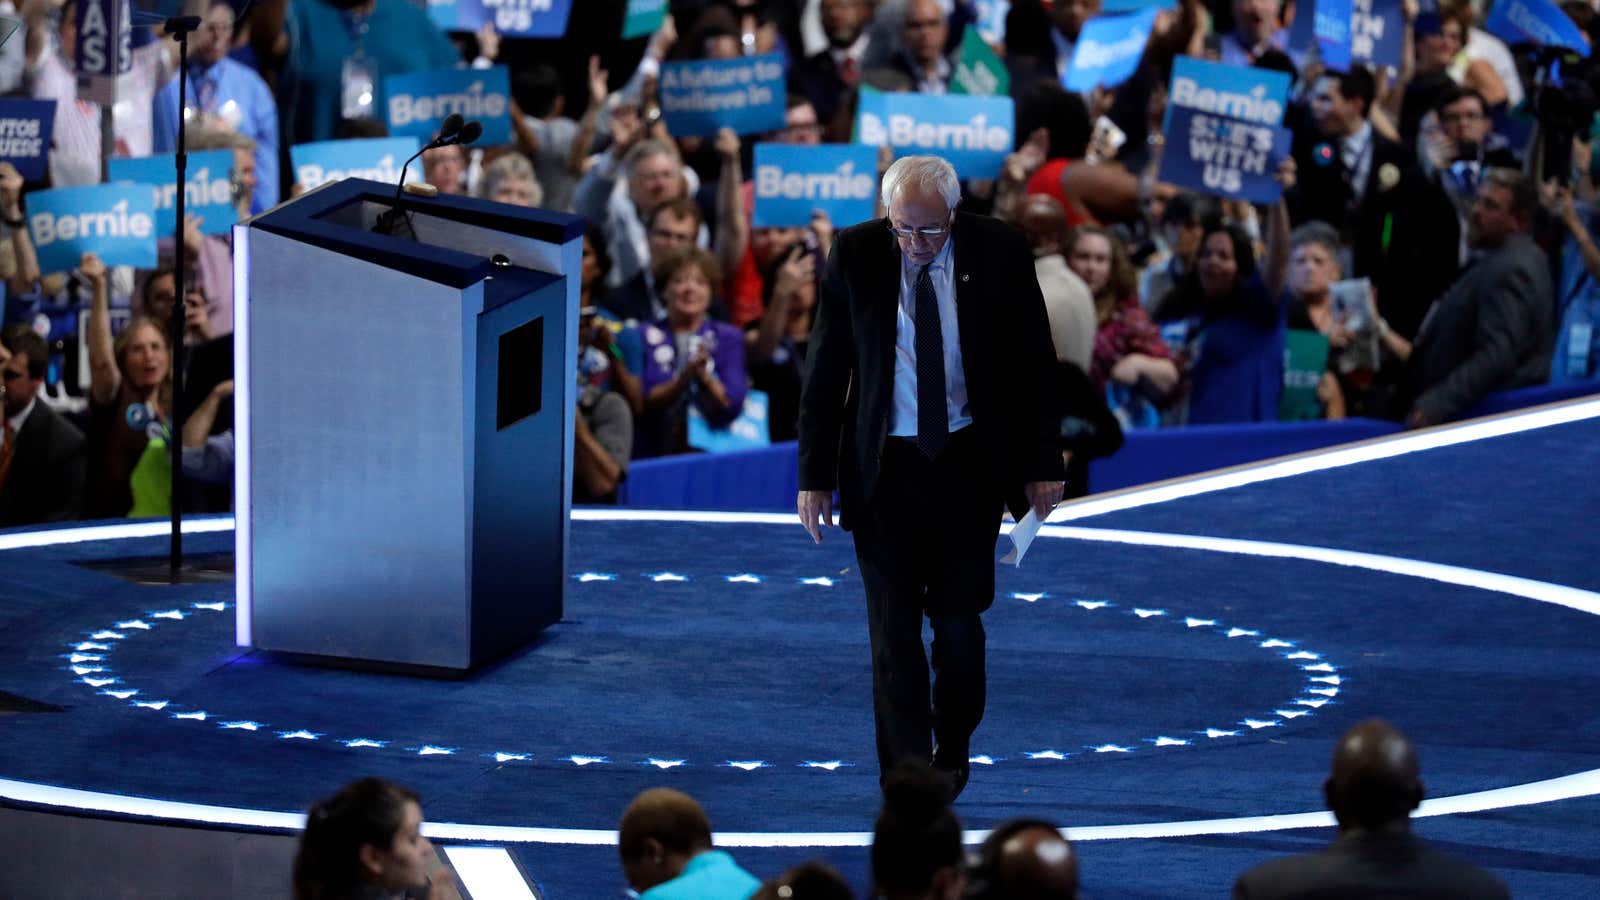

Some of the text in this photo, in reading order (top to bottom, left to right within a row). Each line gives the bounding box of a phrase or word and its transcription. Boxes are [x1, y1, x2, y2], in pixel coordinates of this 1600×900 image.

[662, 61, 781, 88] A future to
[748, 83, 772, 104] in
[388, 80, 505, 127] Bernie
[1172, 77, 1282, 126] Bernie
[888, 113, 1010, 152] Bernie
[1189, 138, 1267, 176] WITH
[153, 167, 232, 209] rnie
[755, 162, 874, 200] Bernie
[1203, 160, 1242, 193] US
[31, 199, 152, 247] Bernie
